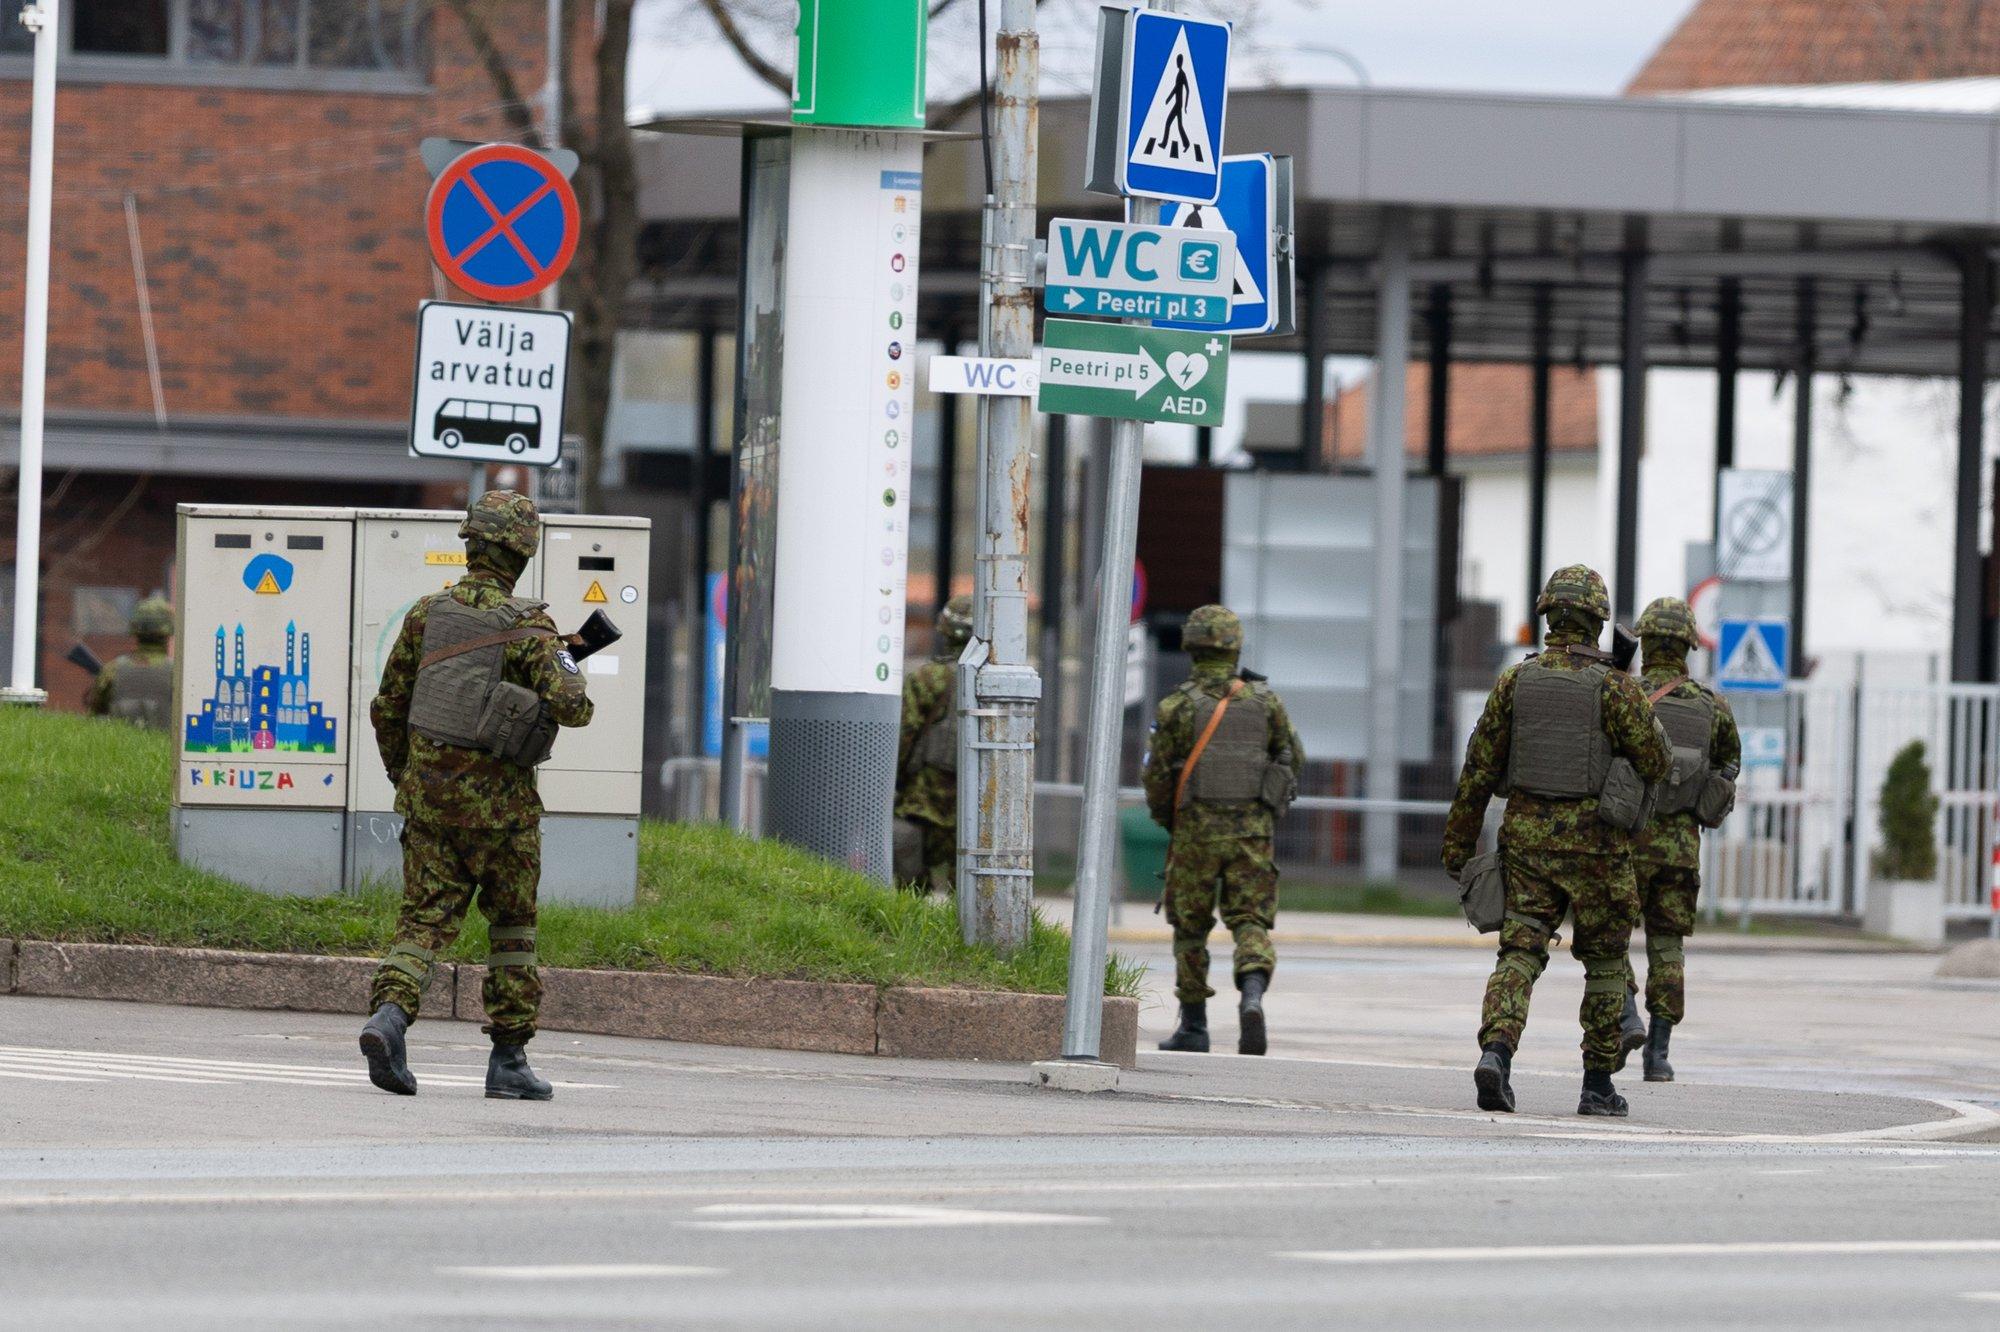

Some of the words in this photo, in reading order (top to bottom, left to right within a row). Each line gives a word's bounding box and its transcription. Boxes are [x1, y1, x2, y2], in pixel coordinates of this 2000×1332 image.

[1059, 226, 1162, 282] WC
[1097, 291, 1161, 315] Peetri
[1167, 298, 1187, 319] pl
[1194, 299, 1206, 317] 3
[455, 319, 534, 356] Välja
[431, 360, 554, 389] arvatud
[963, 362, 1016, 389] WC
[1050, 357, 1109, 377] Peetri
[1115, 364, 1133, 381] pl
[1139, 365, 1149, 380] 5
[1160, 395, 1207, 416] AED
